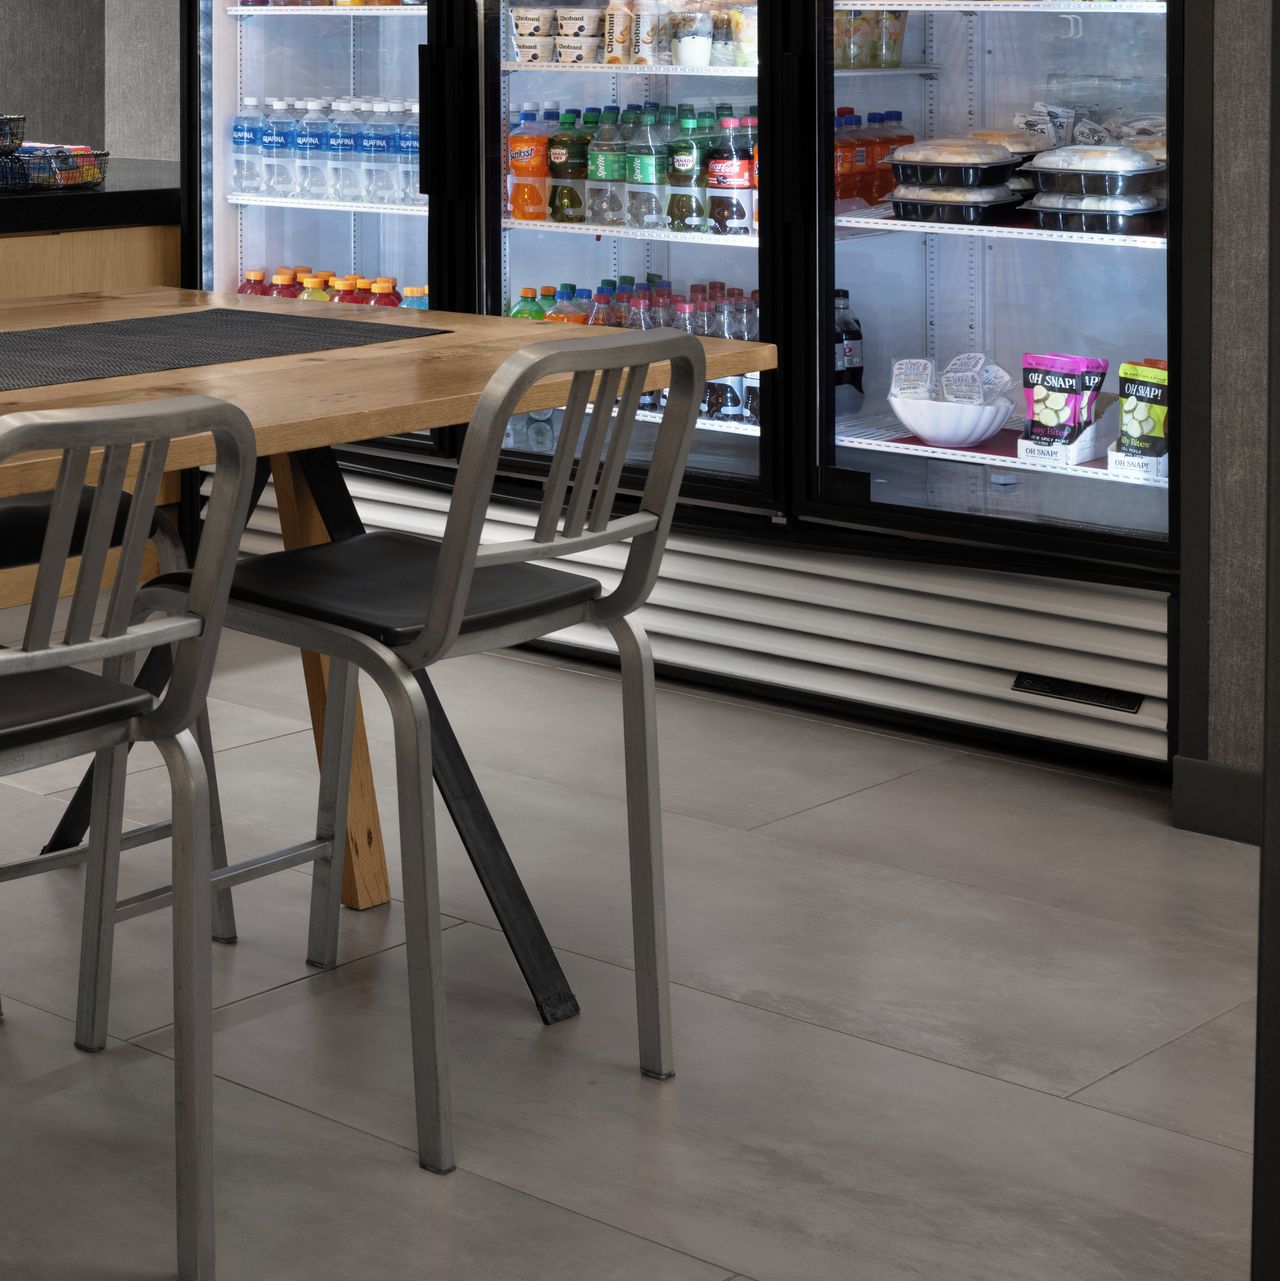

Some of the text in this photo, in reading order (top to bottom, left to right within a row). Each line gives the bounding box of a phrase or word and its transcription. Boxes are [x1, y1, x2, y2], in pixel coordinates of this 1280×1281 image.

[597, 155, 605, 178] Sprite
[1028, 373, 1076, 389] OH SNAP!
[1125, 383, 1162, 399] OH SNAP!
